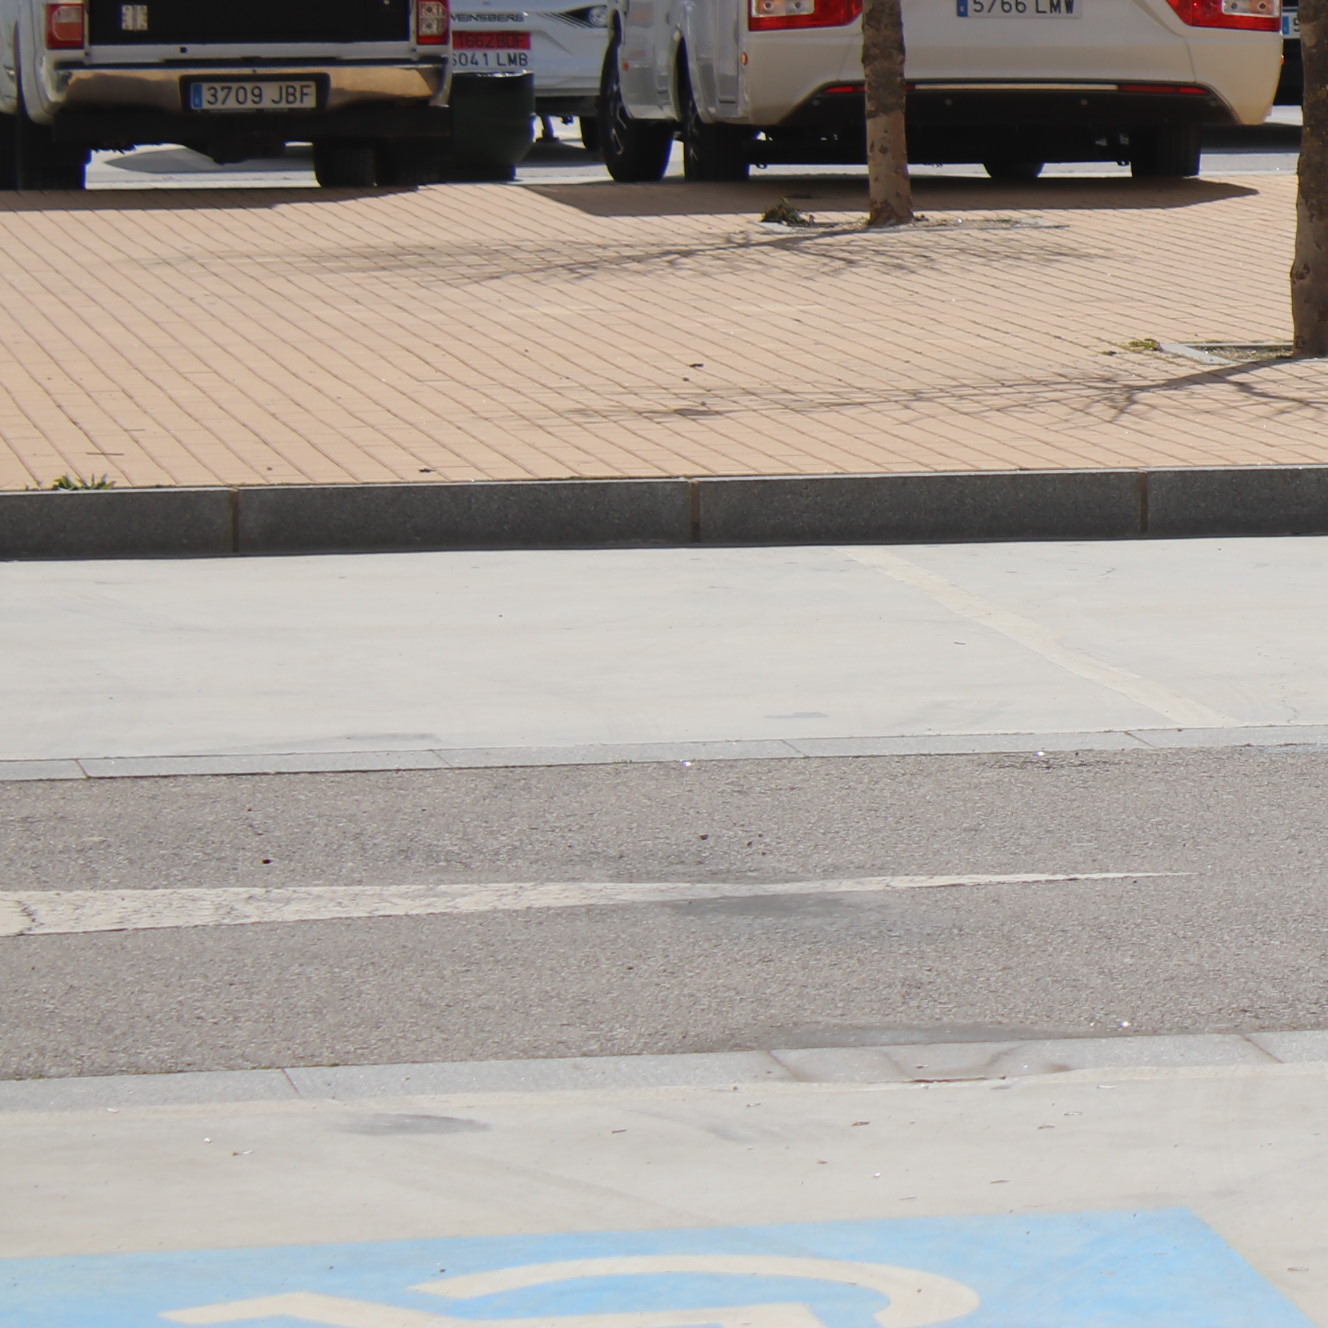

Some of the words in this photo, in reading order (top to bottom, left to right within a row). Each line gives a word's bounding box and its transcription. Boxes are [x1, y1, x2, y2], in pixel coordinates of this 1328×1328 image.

[497, 53, 529, 67] LMB
[207, 86, 264, 105] 3709
[271, 85, 312, 104] JBF
